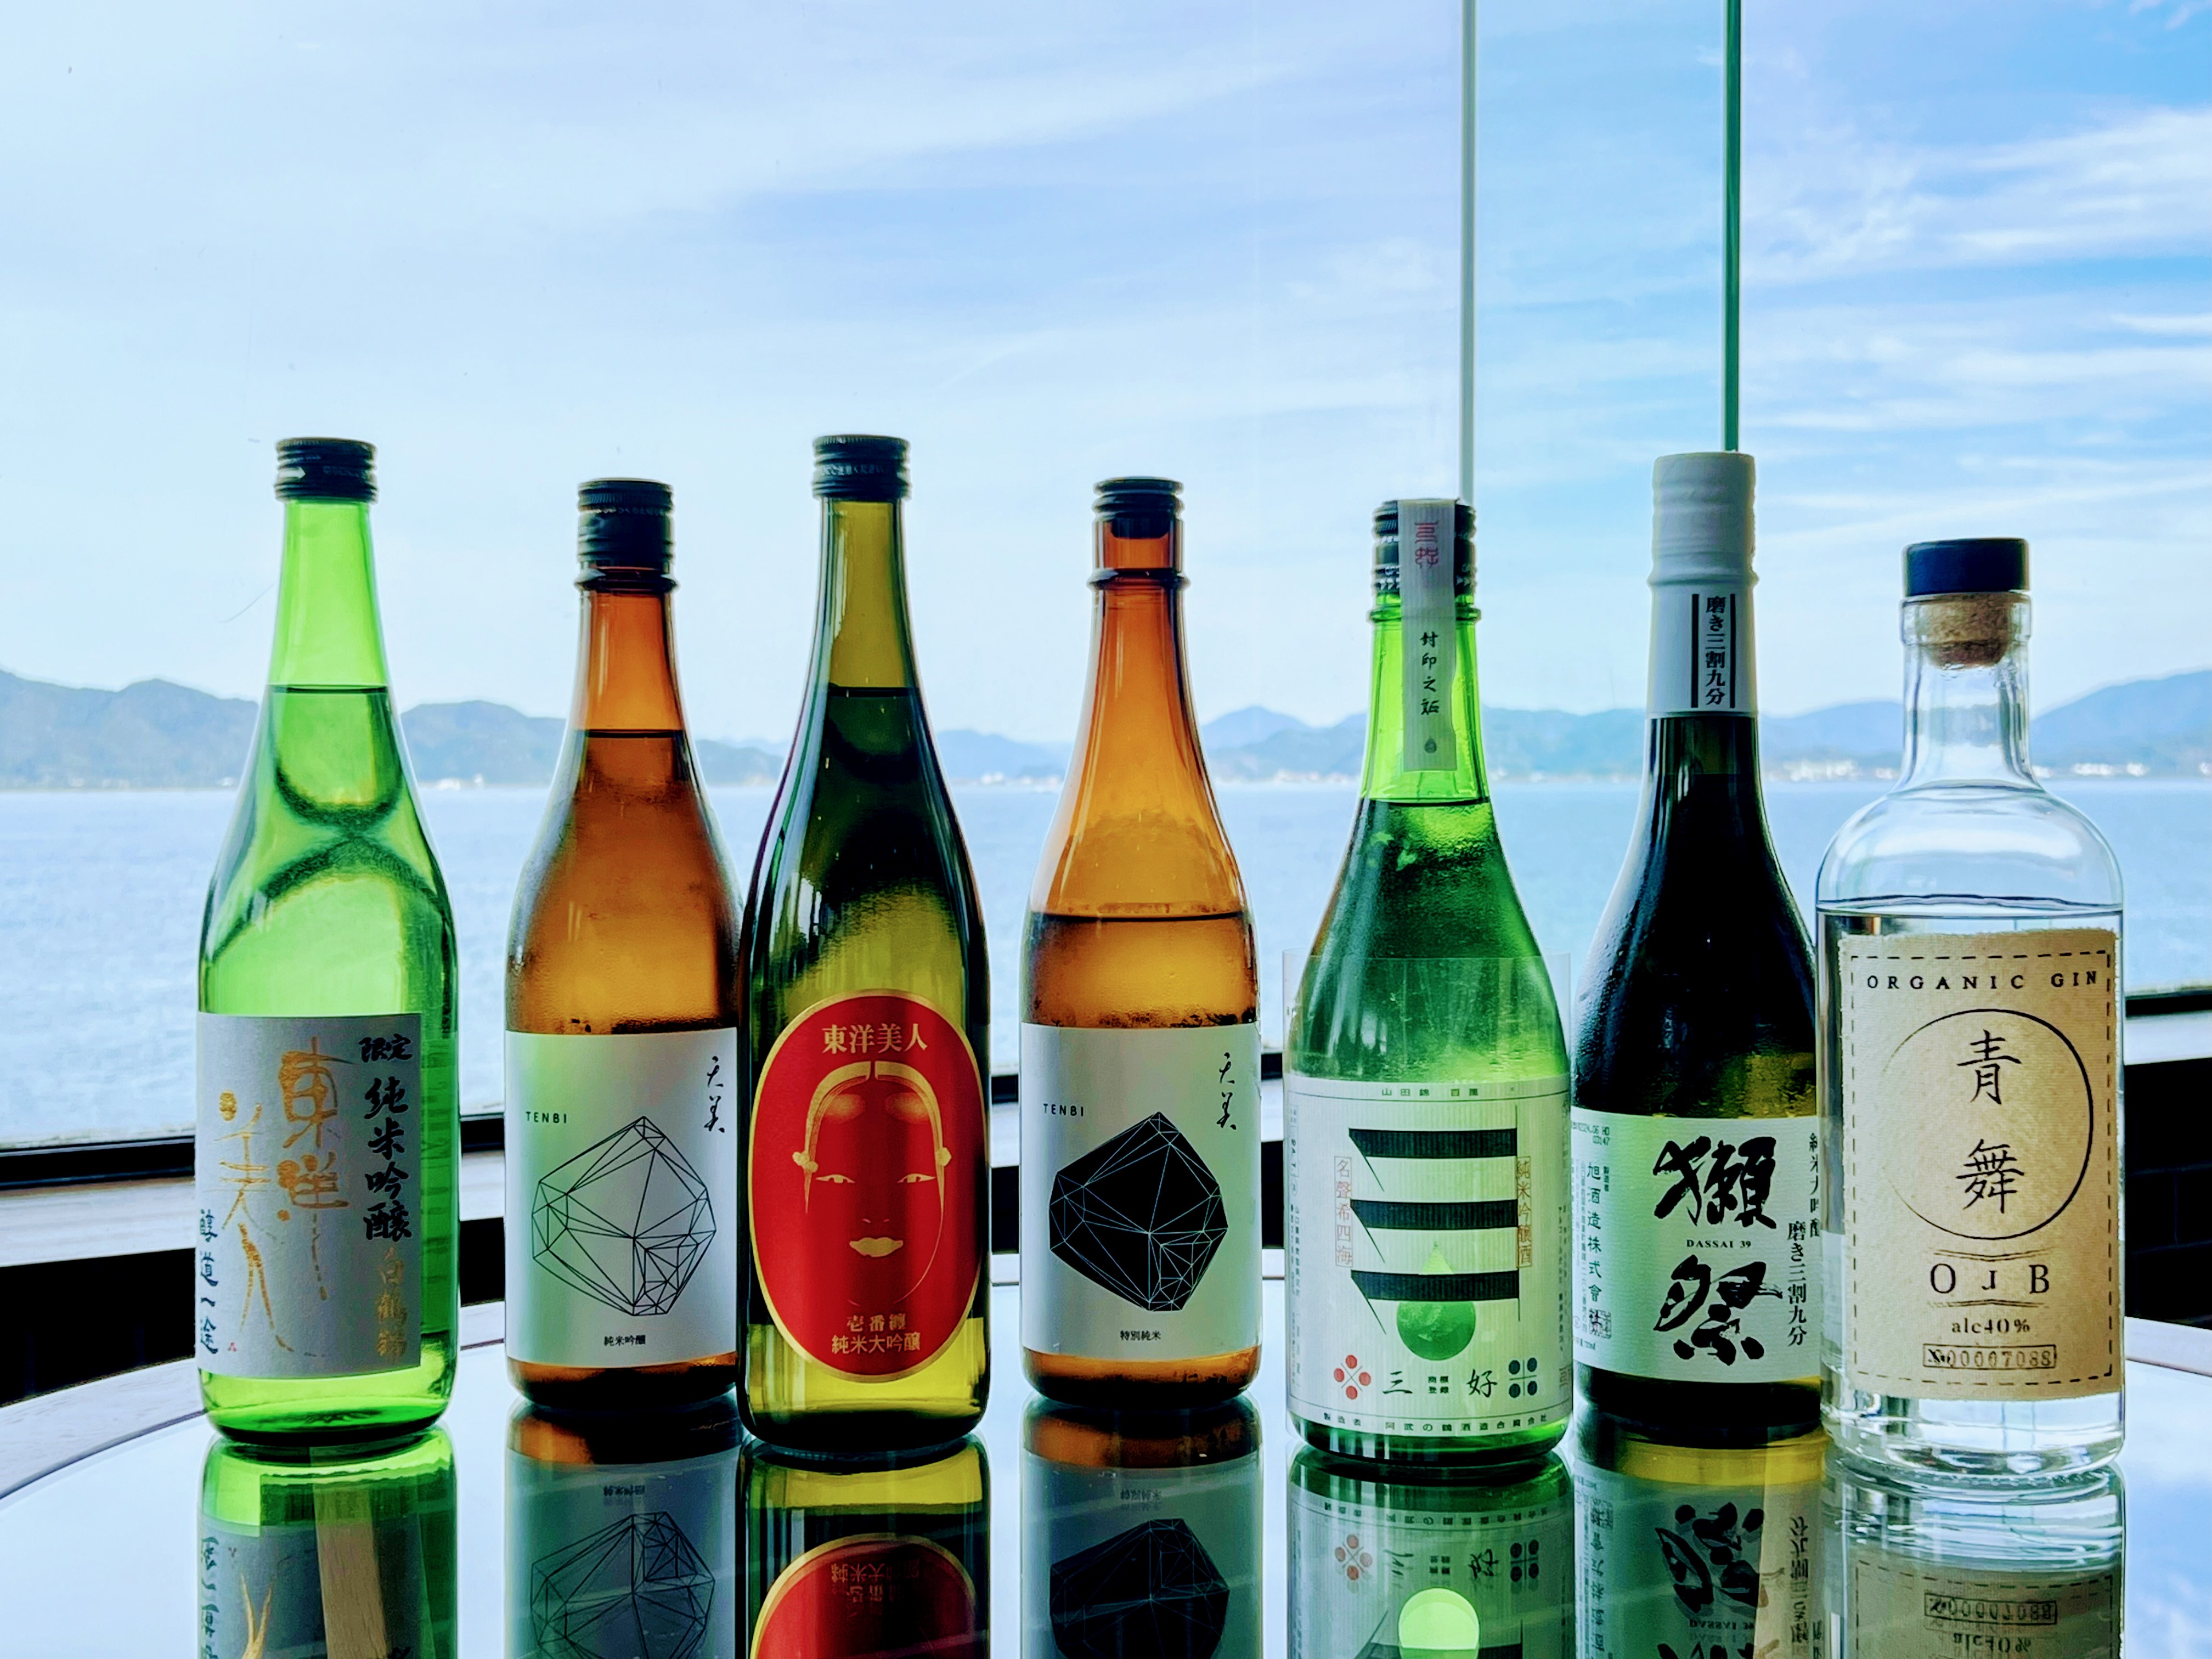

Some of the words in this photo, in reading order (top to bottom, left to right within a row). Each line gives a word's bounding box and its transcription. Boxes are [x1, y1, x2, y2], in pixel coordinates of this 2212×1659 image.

[1705, 595, 1726, 706] 磨き三割九分
[1867, 974, 2024, 990] ORGANIC
[2051, 970, 2098, 988] GIN
[358, 1034, 413, 1063] 限定
[822, 1023, 928, 1053] 東洋美人
[526, 1111, 568, 1124] TENBI
[1044, 1103, 1085, 1117] TENBI
[1956, 1029, 2024, 1214] 青舞
[1686, 1239, 1734, 1249] DASSAI
[1740, 1239, 1752, 1249] 39
[1787, 1221, 1807, 1347] 磨き三割九分
[1120, 1330, 1161, 1341] 特別純米
